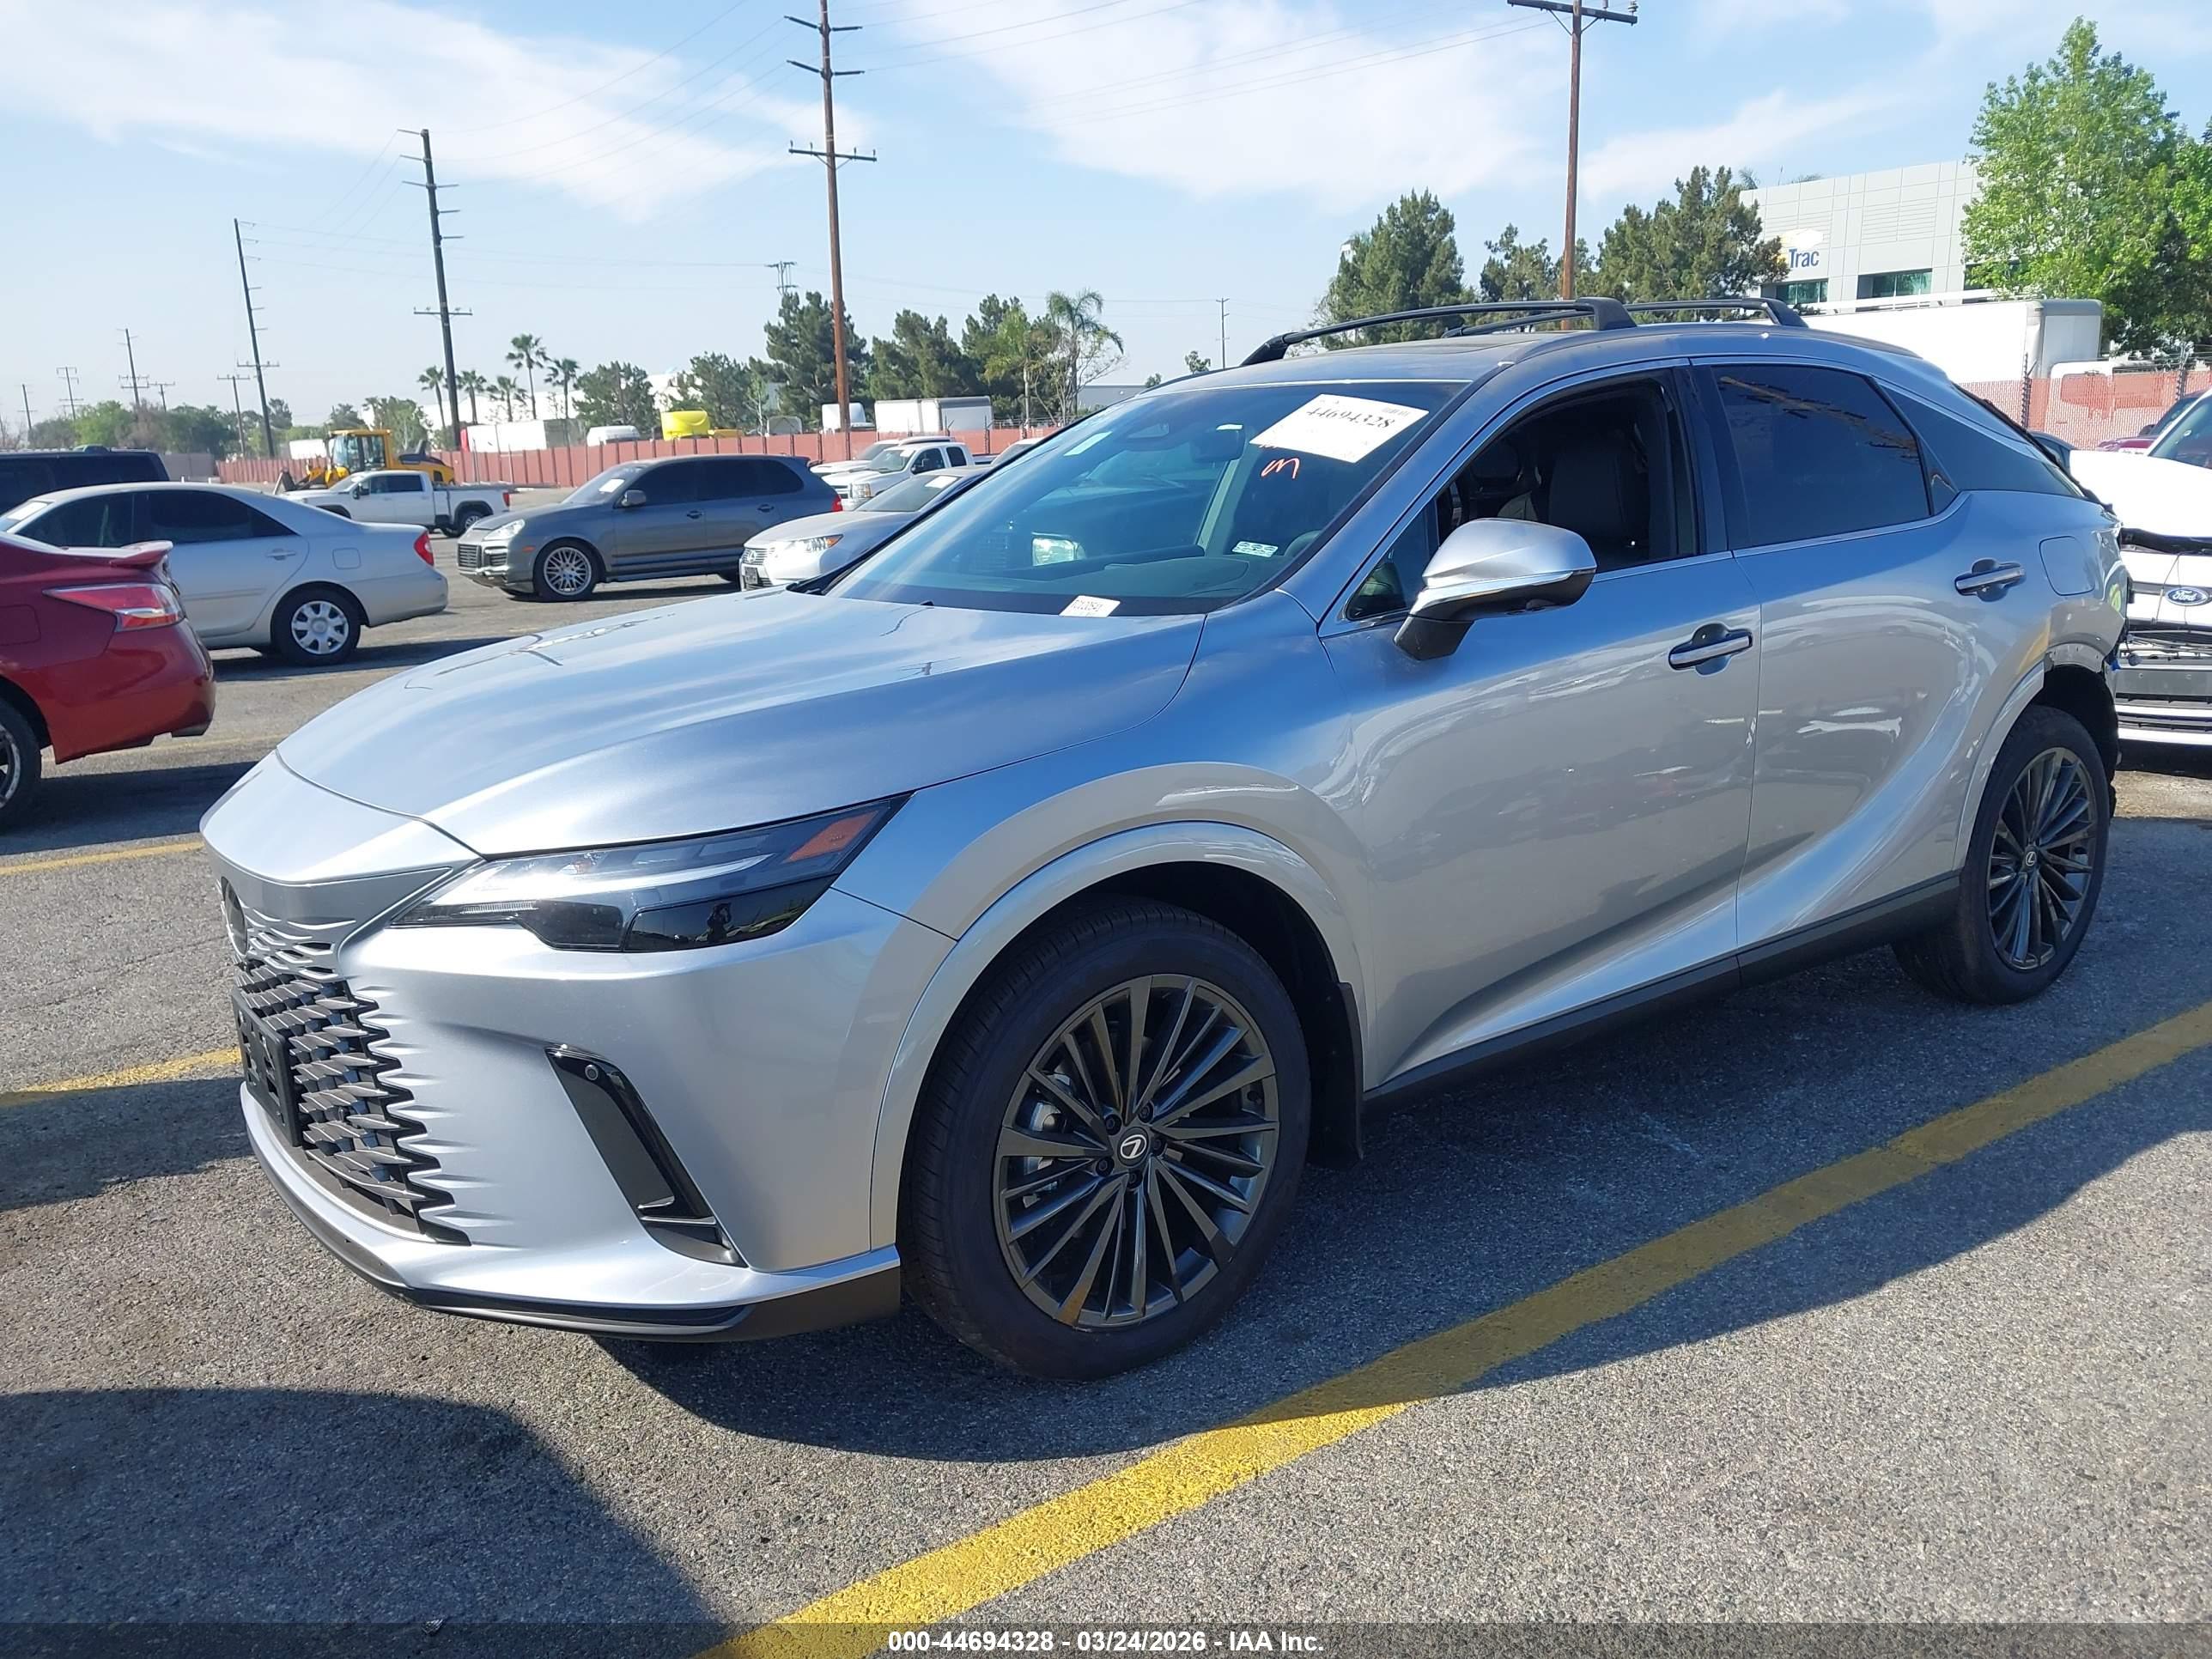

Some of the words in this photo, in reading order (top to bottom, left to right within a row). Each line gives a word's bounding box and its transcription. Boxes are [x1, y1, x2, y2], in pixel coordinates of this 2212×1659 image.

[1789, 248, 1820, 269] Trac
[1306, 407, 1396, 428] 44694328
[2172, 589, 2198, 601] Ford
